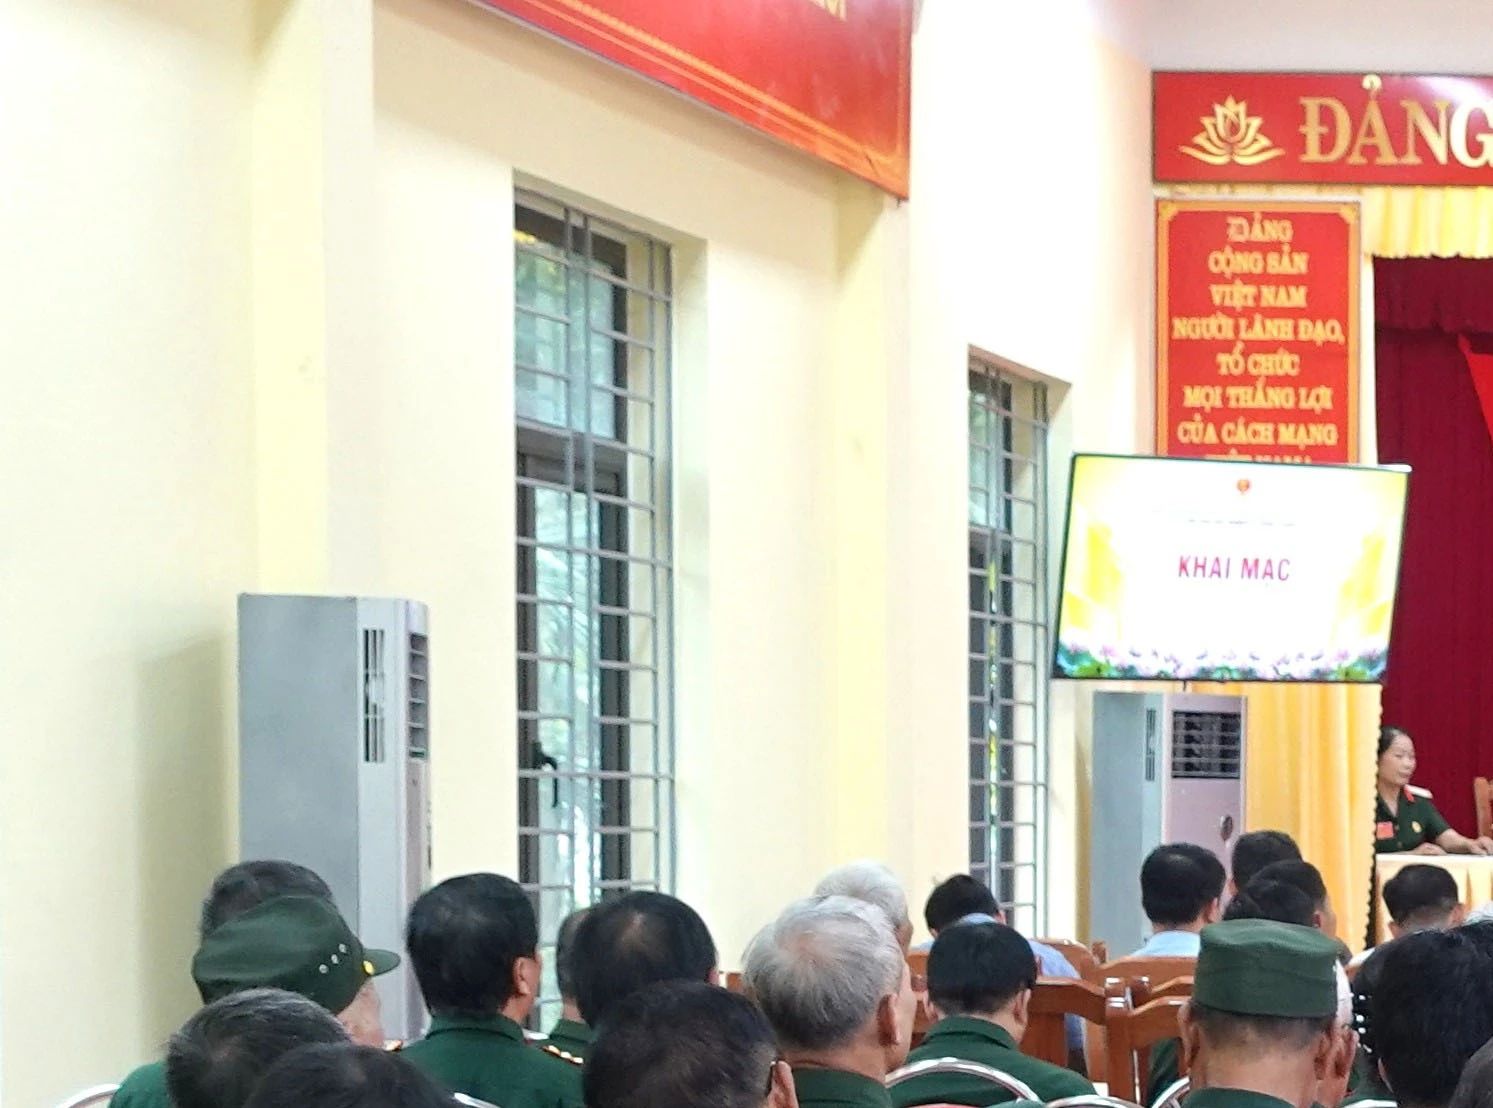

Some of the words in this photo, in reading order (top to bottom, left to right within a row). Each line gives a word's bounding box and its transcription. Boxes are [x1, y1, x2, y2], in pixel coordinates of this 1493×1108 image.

[1226, 211, 1294, 243] ĐẢNG
[1208, 245, 1265, 280] CỘNG
[1266, 243, 1309, 275] SẢN
[1209, 279, 1258, 312] VIỆT
[1259, 284, 1308, 307] NAM
[1172, 312, 1235, 341] NGƯỜI
[1239, 313, 1296, 341] LÃNH
[1297, 318, 1345, 347] ĐẠO,
[1216, 341, 1245, 376] TỔ
[1247, 347, 1300, 376] CHỨC
[1183, 385, 1222, 413] MỌI
[1226, 376, 1296, 409] THẮNG
[1298, 386, 1333, 414] LỢI
[1177, 413, 1219, 444] CỦA
[1221, 416, 1275, 445] CÁCH
[1278, 423, 1338, 451] MẠNG
[1178, 555, 1231, 580] KHAI
